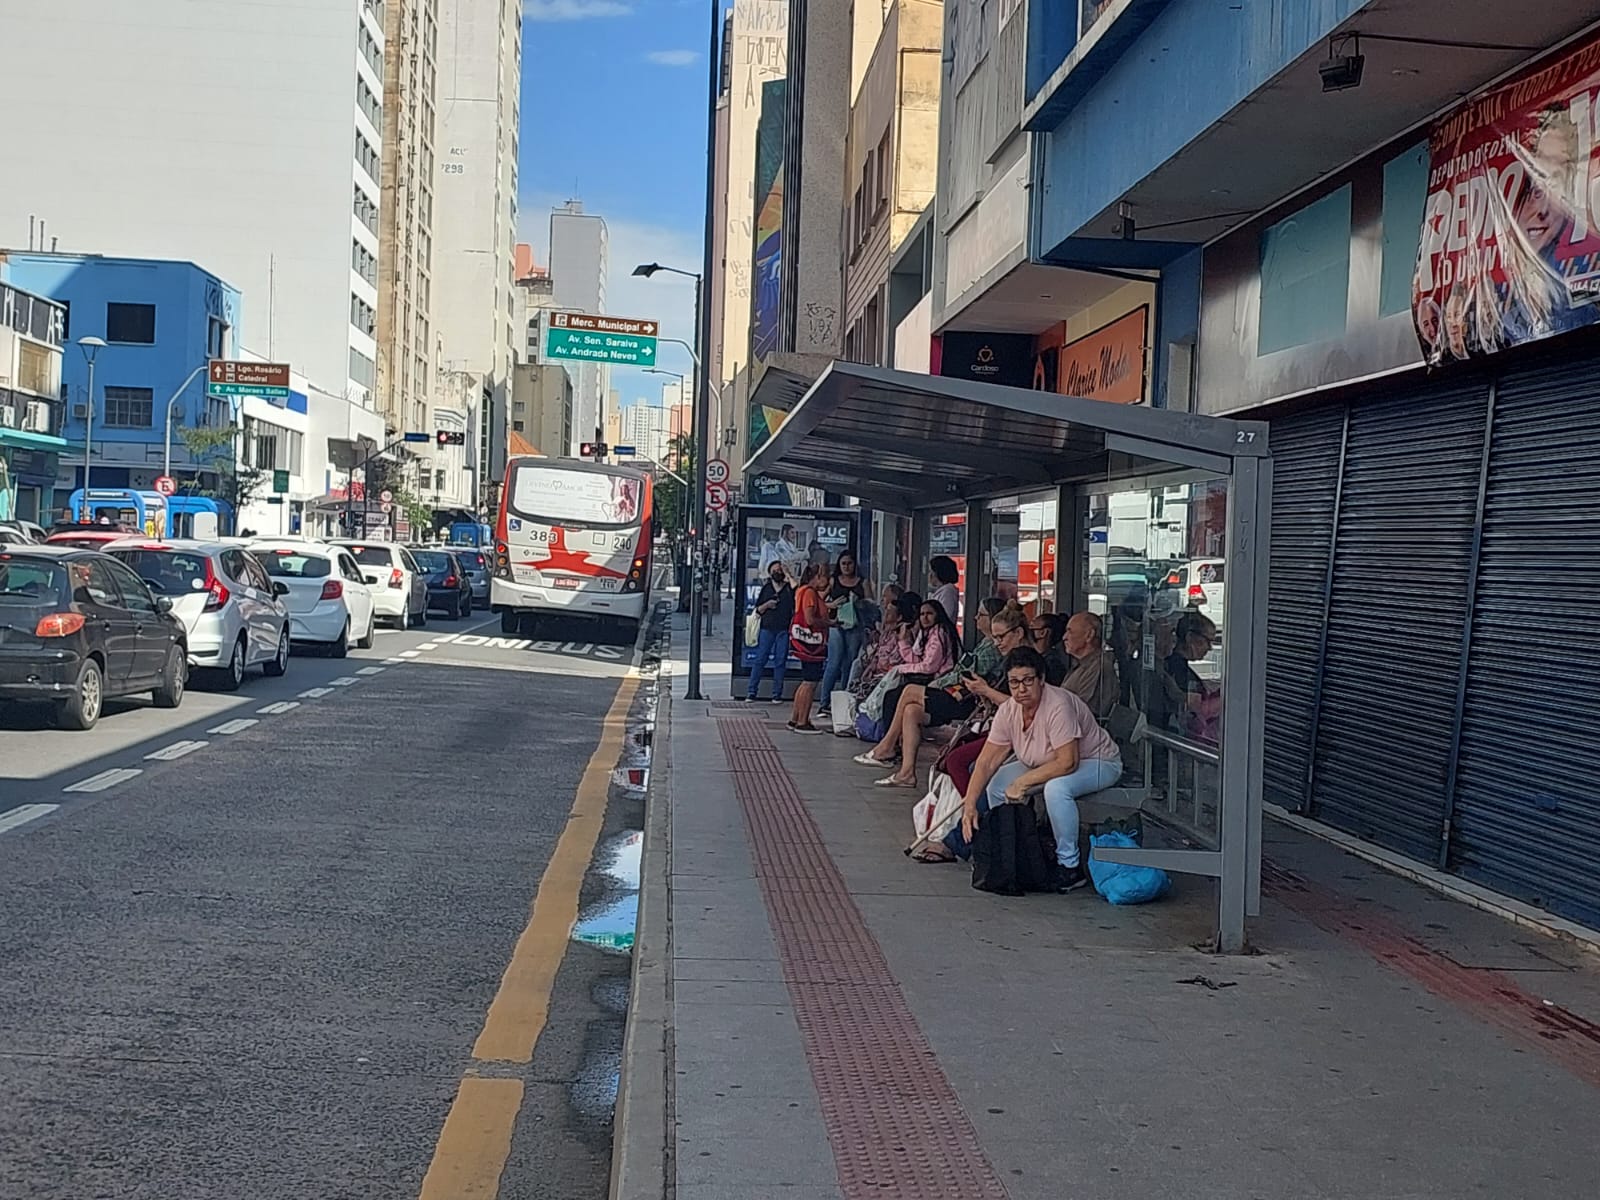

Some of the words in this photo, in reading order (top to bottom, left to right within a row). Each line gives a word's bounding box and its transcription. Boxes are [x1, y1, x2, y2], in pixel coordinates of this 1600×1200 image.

[1510, 65, 1561, 111] HADDAD
[1573, 42, 1600, 77] PED
[1430, 145, 1483, 187] DEPUTADO
[571, 316, 596, 328] Merc.
[598, 319, 640, 332] Municipal
[568, 334, 582, 343] Av.
[584, 336, 604, 346] Sen.
[606, 337, 638, 349] Saraiva
[555, 345, 569, 355] Av.
[571, 347, 608, 358] Andrade
[610, 350, 637, 361] Neves
[237, 365, 254, 374] Lgo.
[254, 366, 282, 374] Rosário
[238, 374, 268, 383] Catedral
[1236, 431, 1256, 443] 27
[708, 465, 725, 477] 50
[529, 530, 557, 543] 383
[817, 526, 847, 538] PUC
[613, 536, 632, 550] 240
